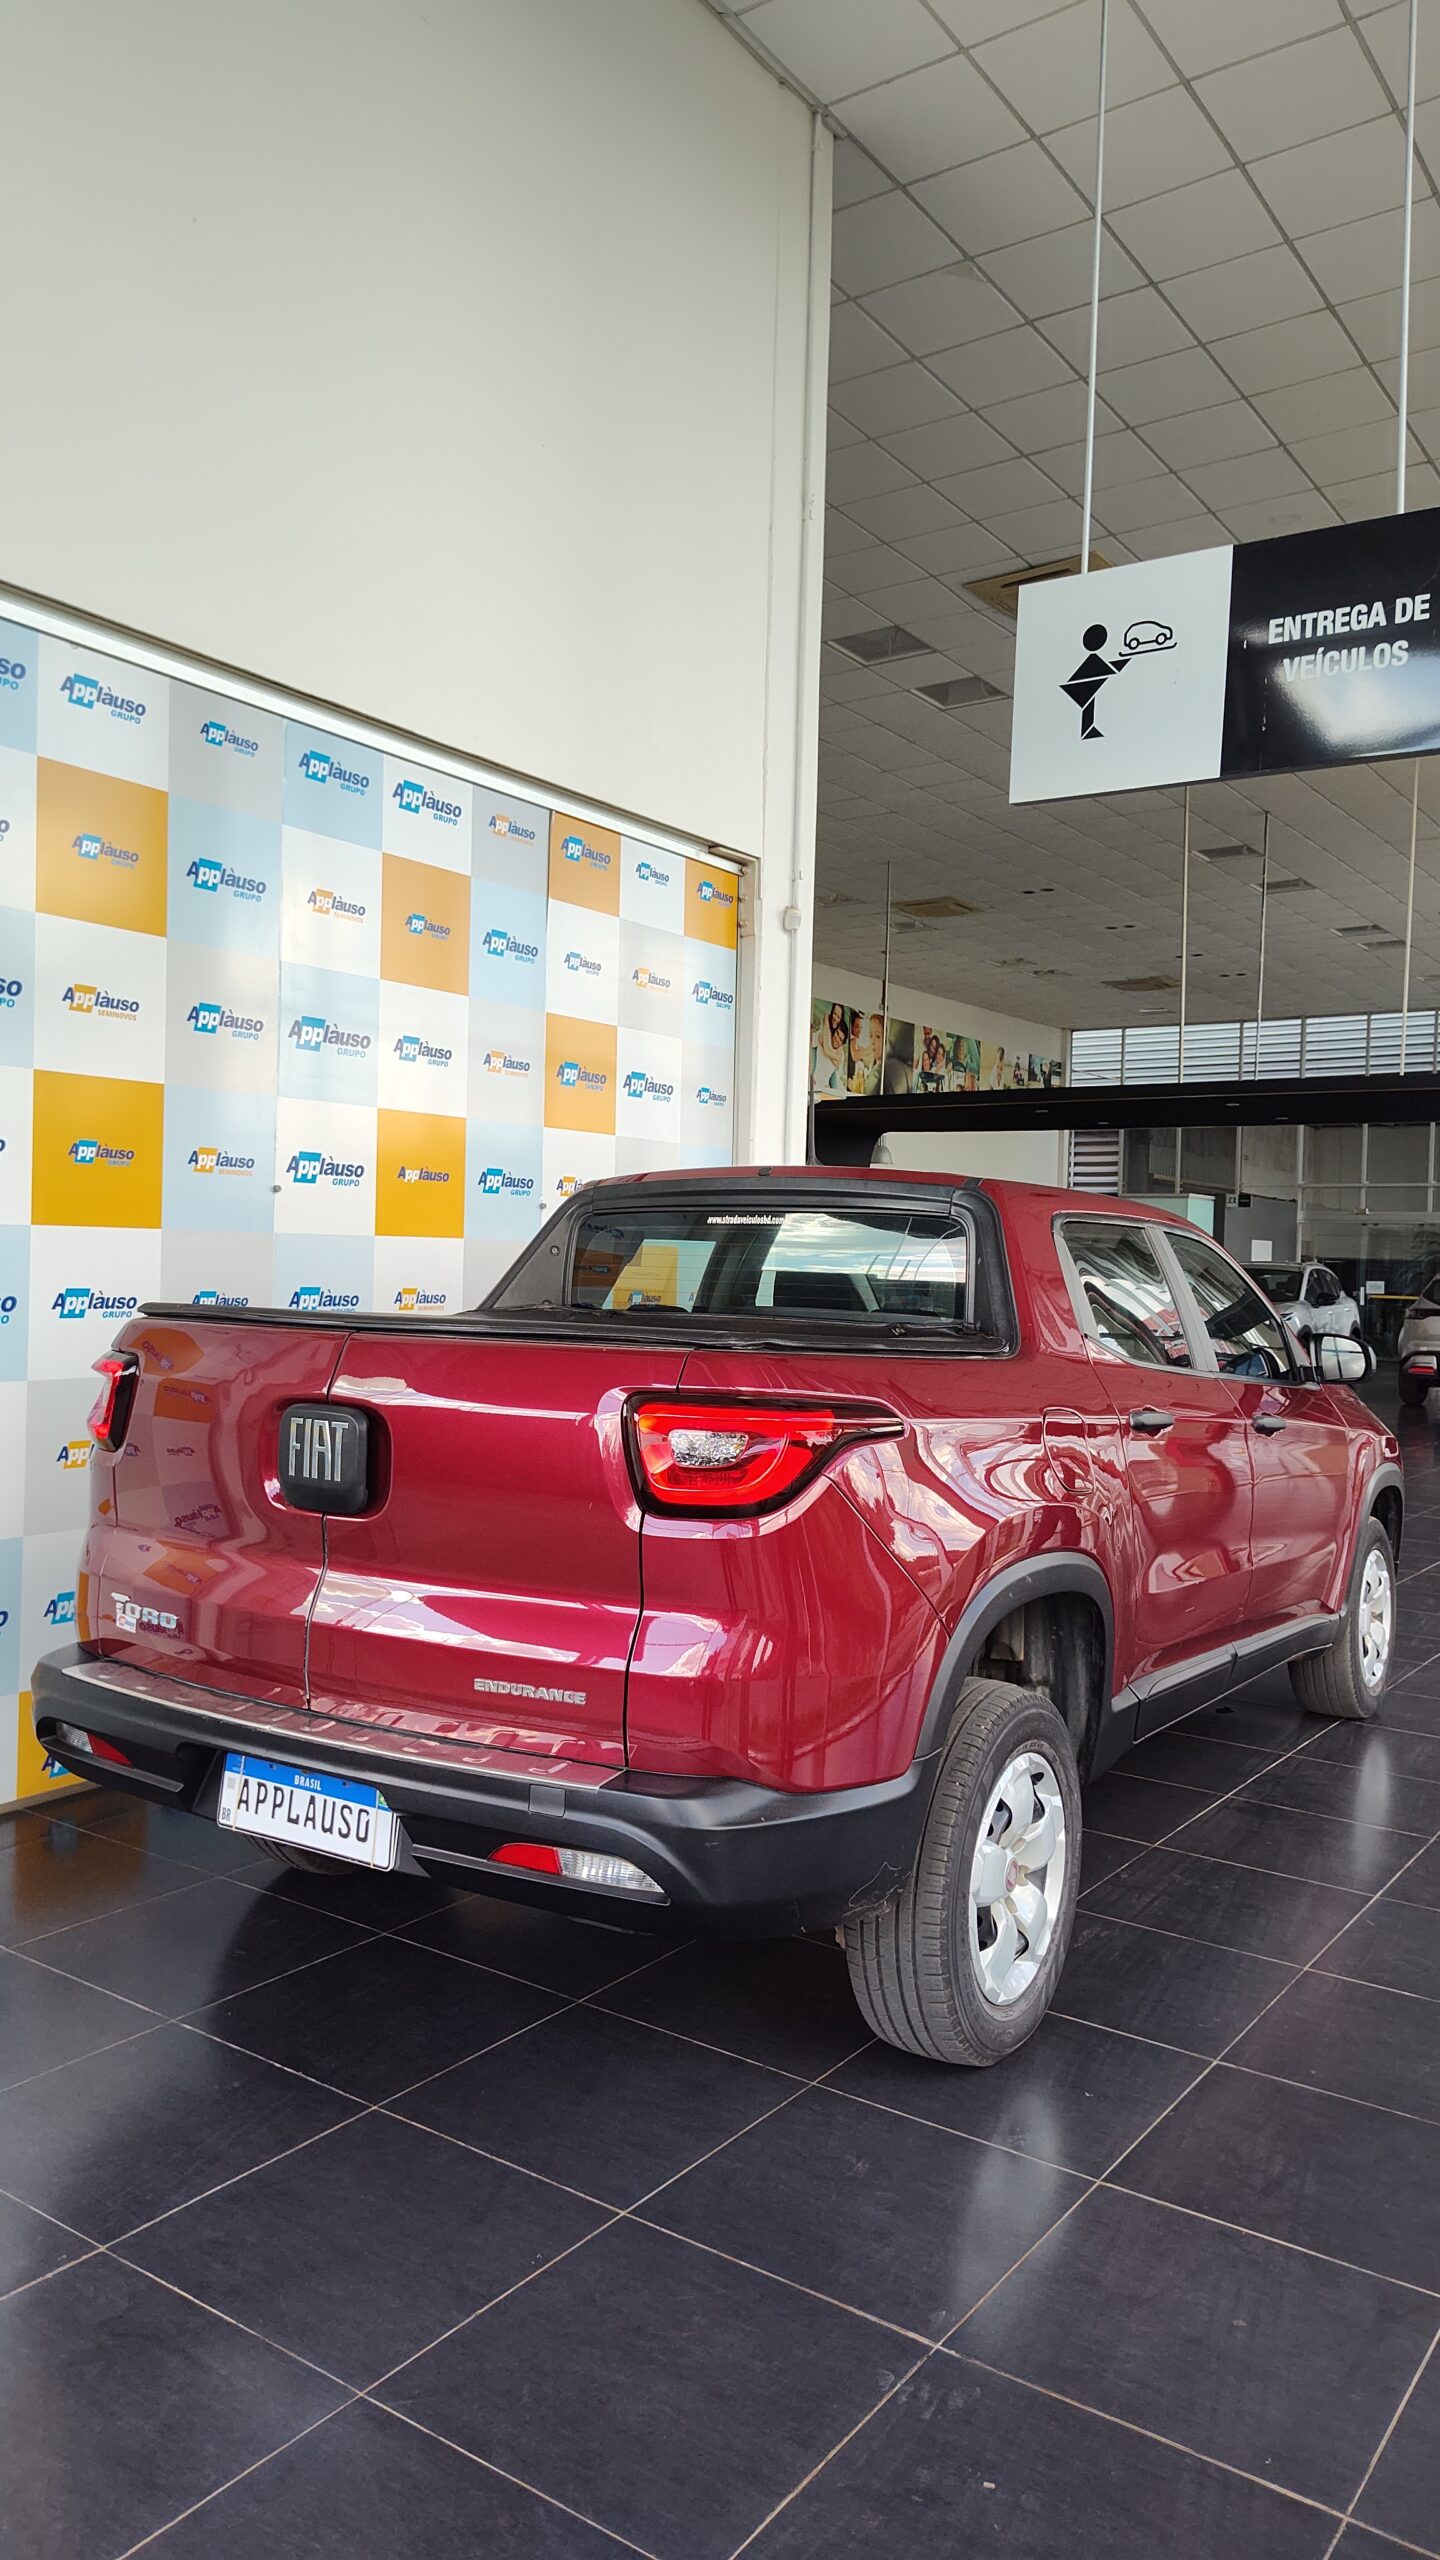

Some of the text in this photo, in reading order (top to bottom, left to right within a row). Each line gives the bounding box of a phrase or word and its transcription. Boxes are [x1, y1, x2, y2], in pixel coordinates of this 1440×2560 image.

[1268, 593, 1431, 644] ENTREGA DE
[1283, 639, 1409, 683] VEÍCULOS
[60, 675, 146, 716] Applàuso
[110, 709, 142, 725] GRUPO
[200, 722, 259, 751] Applàuso
[298, 752, 370, 788] Applàuso
[340, 783, 366, 796] GRUPO
[392, 782, 462, 818] Applàuso
[433, 813, 458, 826] GRUPO
[487, 815, 536, 840] Applàuso
[71, 835, 139, 863] Applàuso
[560, 837, 611, 865] Applàuso
[186, 860, 267, 894] Applàuso
[635, 862, 670, 883] Applàuso
[233, 890, 262, 903] GRUPO
[307, 890, 366, 916] Applàuso
[696, 883, 734, 904] Applàuso
[405, 915, 451, 936] Applàuso
[482, 931, 539, 957] Applàuso
[514, 953, 536, 965] GRUPO
[62, 987, 140, 1013] Applàuso
[692, 983, 734, 1004] Applàuso
[97, 1009, 138, 1022] SEMINOVOS
[187, 1006, 264, 1032] Applàuso
[232, 1030, 260, 1041] GRUPO
[287, 1019, 371, 1049] Applàuso
[336, 1047, 367, 1059] GRUPO
[393, 1038, 453, 1061] Applàuso
[427, 1058, 449, 1068] GRUPO
[483, 1053, 531, 1072] Applàuso
[556, 1064, 607, 1085] Applàuso
[622, 1074, 674, 1096] Applàuso
[652, 1093, 671, 1103] GRUPO
[68, 1142, 135, 1161] Applàuso
[187, 1150, 255, 1170] Applàuso
[286, 1155, 366, 1179] Applàuso
[397, 1166, 451, 1184] Applàuso
[332, 1178, 361, 1187] GRUPO
[477, 1170, 534, 1190] Applàuso
[510, 1189, 531, 1197] GRUPO
[51, 1290, 138, 1312] Applàuso
[393, 1290, 447, 1306] Applàuso
[102, 1310, 133, 1319] GRUPO
[288, 1416, 349, 1482] FIAT
[474, 1678, 587, 1705] ENDURANCE
[294, 1775, 322, 1791] BRASIL
[221, 1807, 232, 1822] BR
[237, 1778, 371, 1843] APPLAUSO
